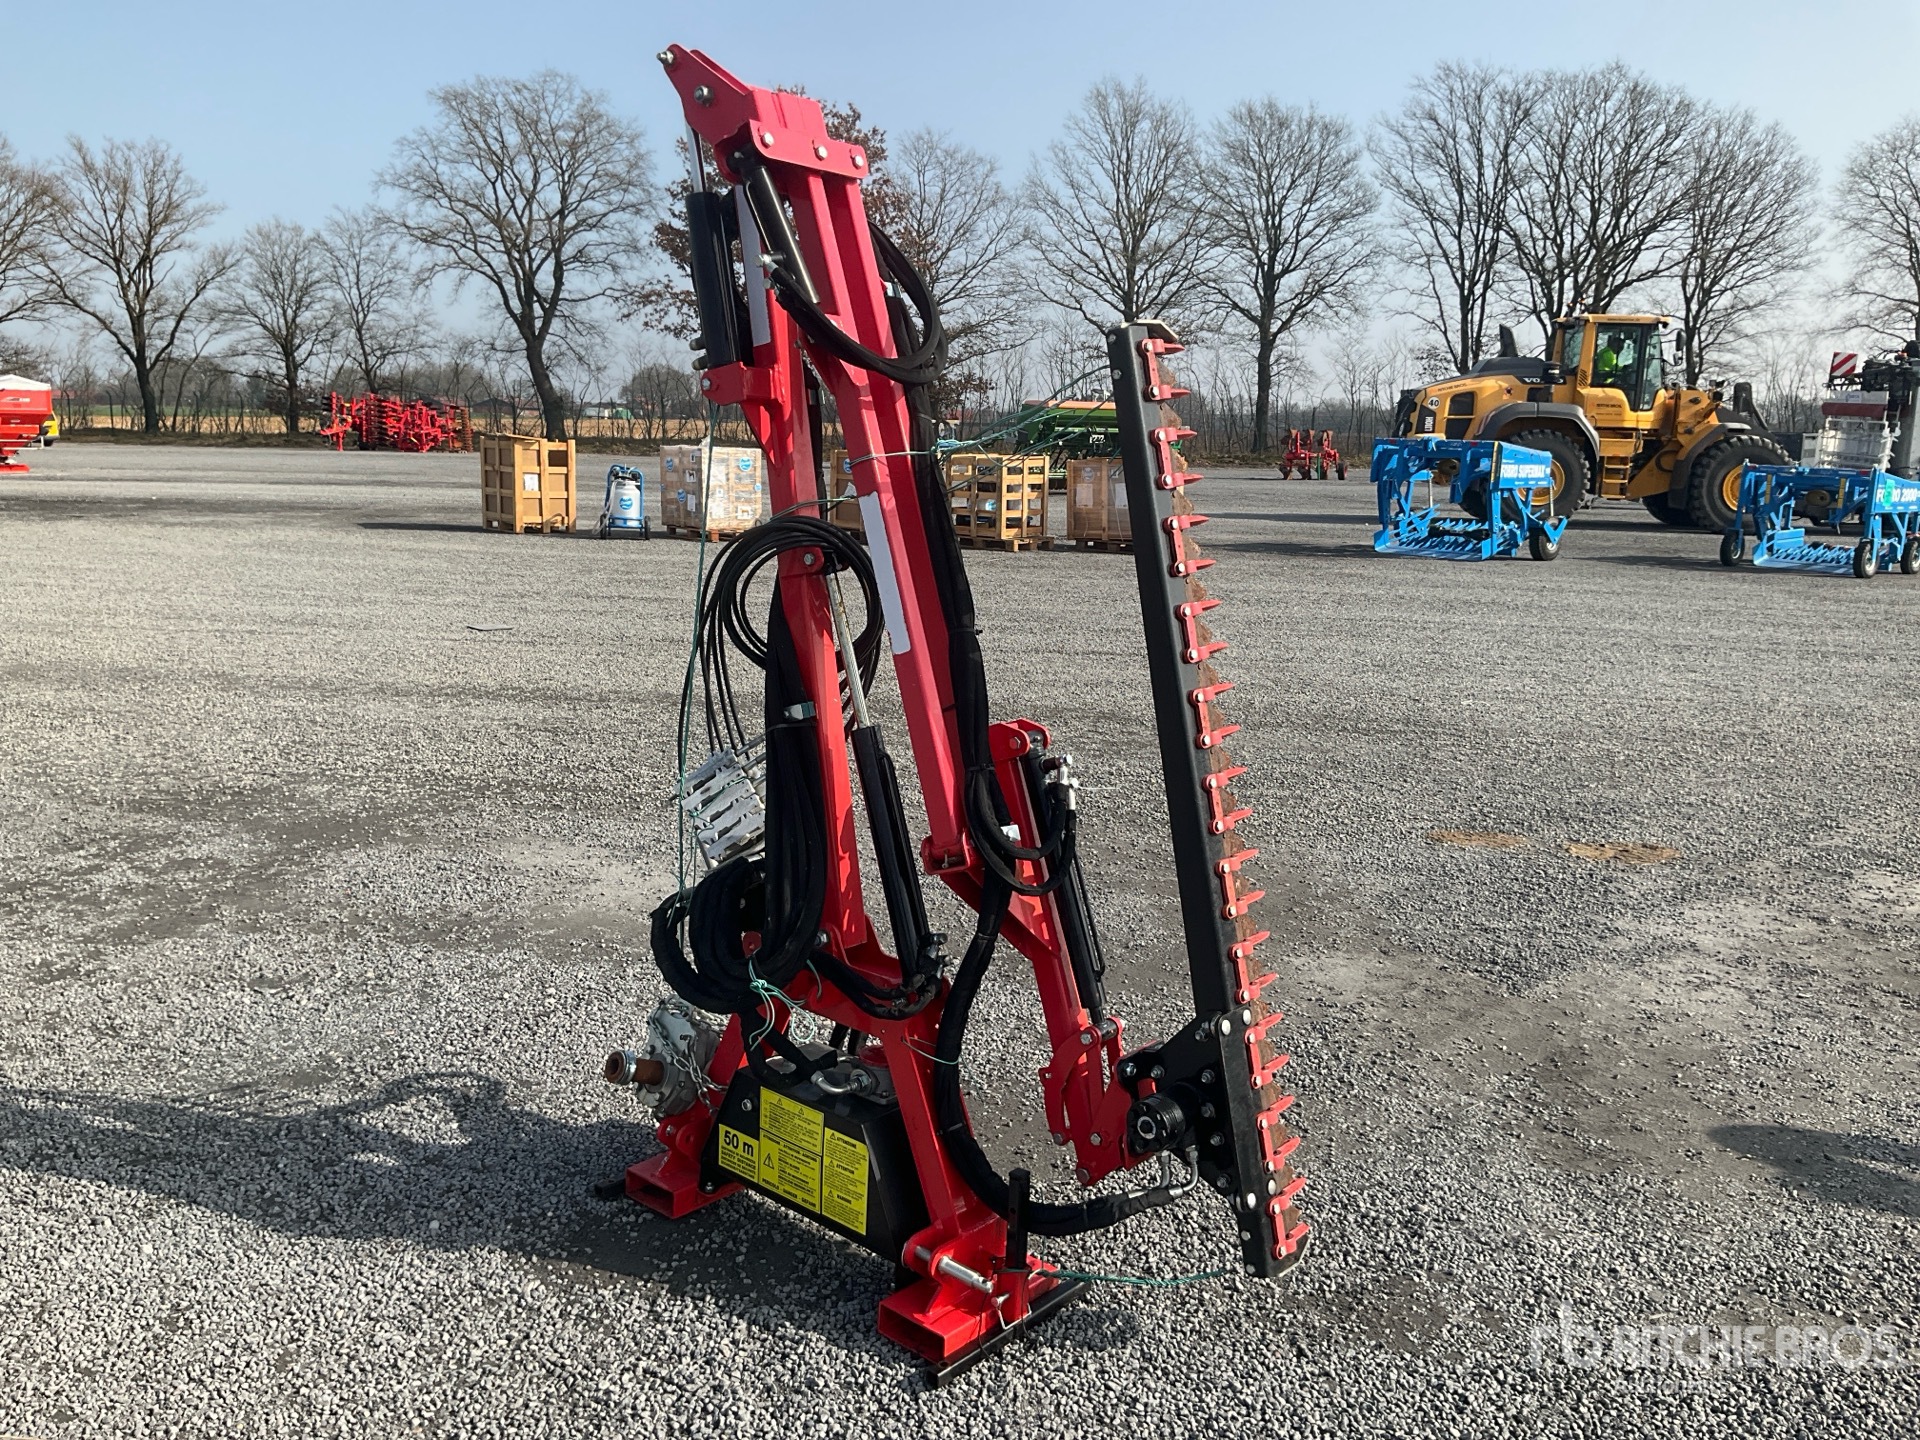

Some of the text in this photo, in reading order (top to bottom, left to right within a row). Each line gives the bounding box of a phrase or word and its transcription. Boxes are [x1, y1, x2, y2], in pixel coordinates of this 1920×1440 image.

[724, 1130, 753, 1157] 50 m
[836, 1163, 854, 1175] ATTENTION
